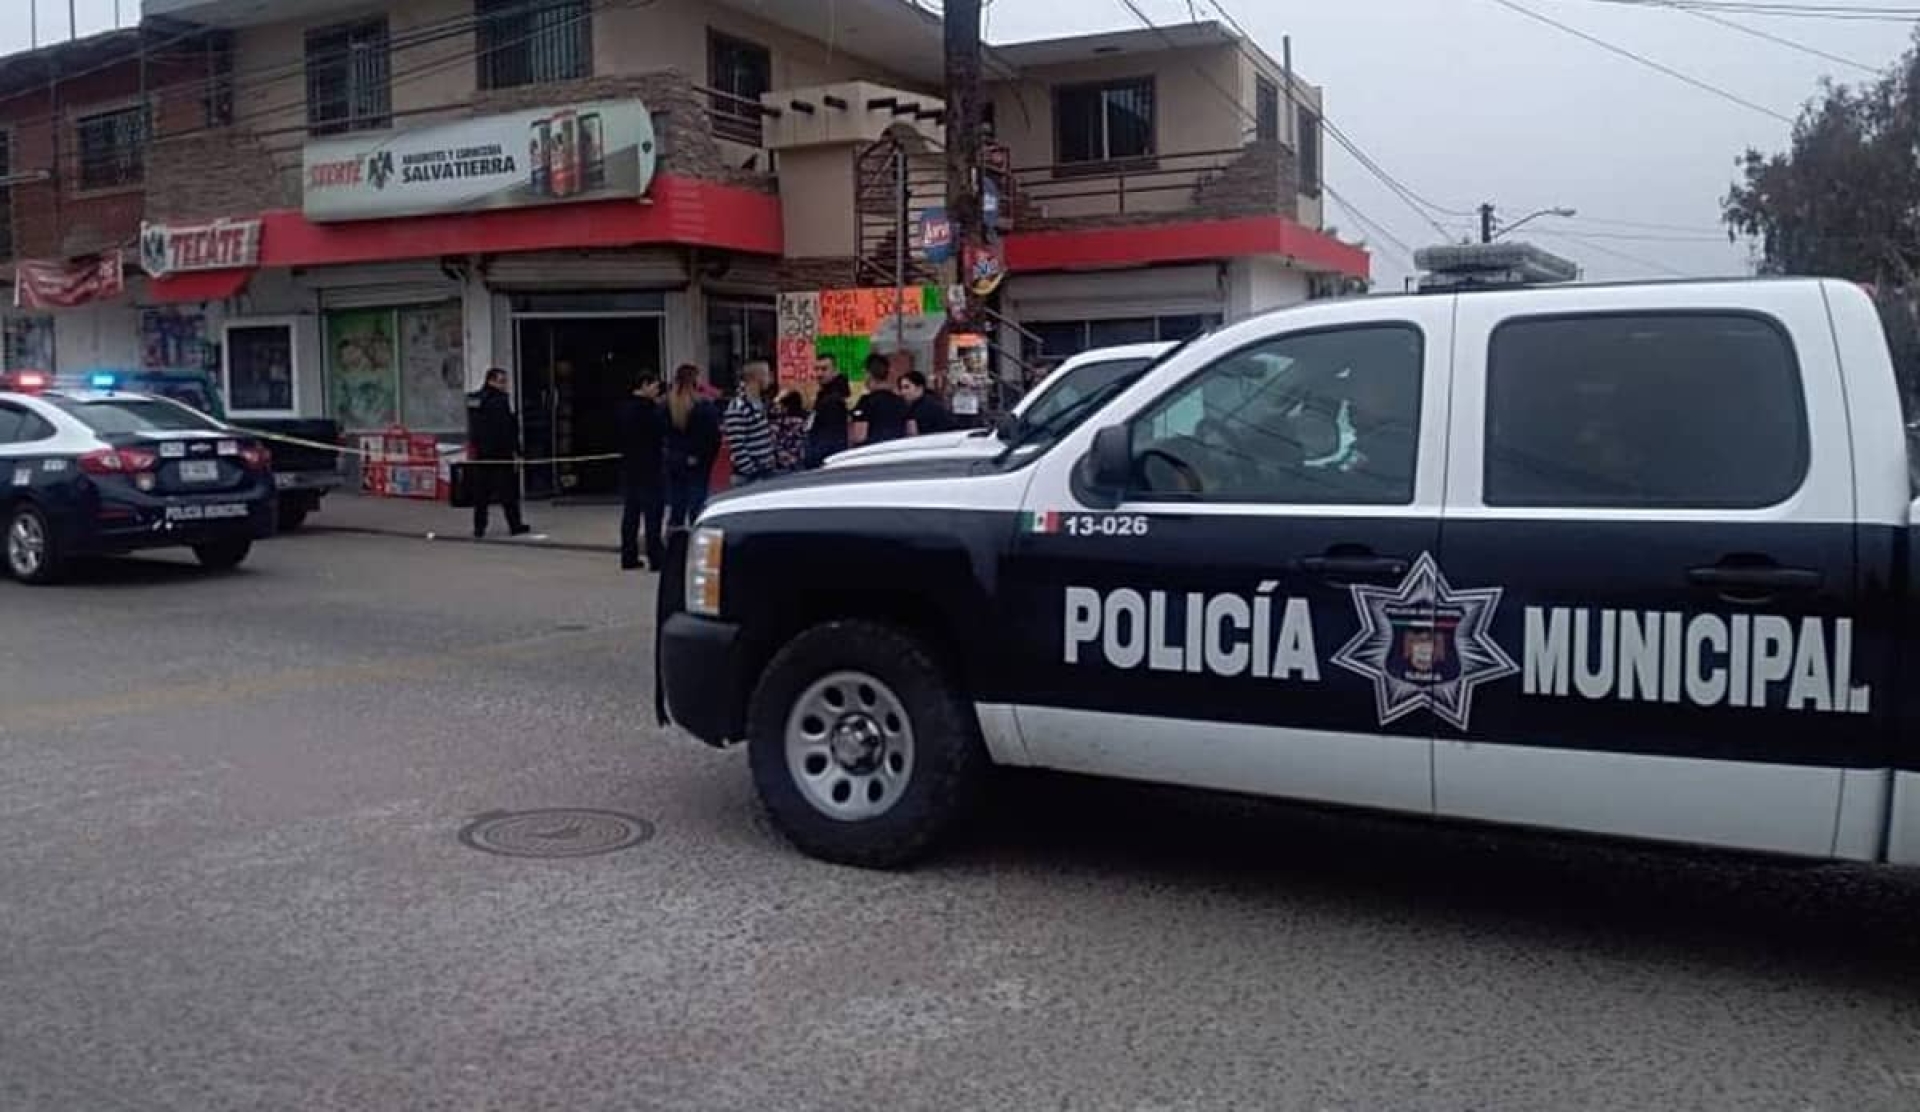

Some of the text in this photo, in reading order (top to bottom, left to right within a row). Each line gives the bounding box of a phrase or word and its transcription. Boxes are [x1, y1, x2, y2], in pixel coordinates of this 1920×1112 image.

[402, 156, 515, 184] SALVATIERRA
[168, 226, 245, 268] TECATE
[1065, 516, 1149, 536] 13-026
[1063, 580, 1870, 713] POLICÍA MUNICIPAL
